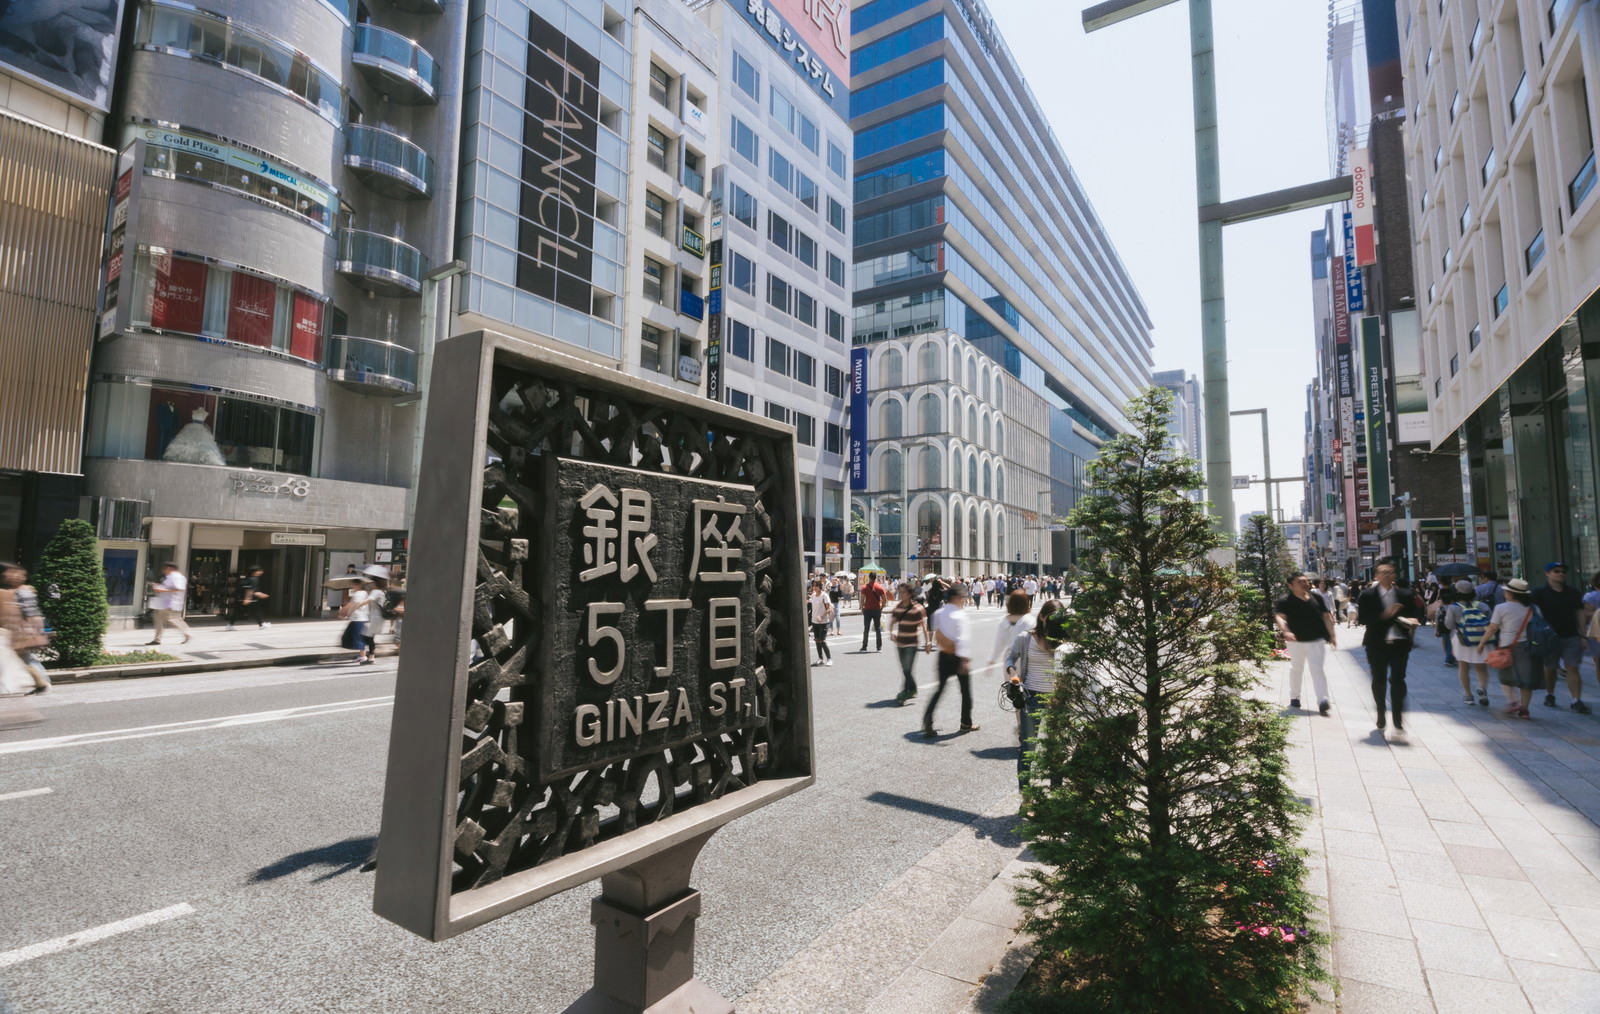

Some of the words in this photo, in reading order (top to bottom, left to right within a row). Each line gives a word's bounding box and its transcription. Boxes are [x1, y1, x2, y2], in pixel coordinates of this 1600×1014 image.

[163, 133, 190, 148] Gold
[193, 140, 220, 155] Plaza
[537, 47, 585, 268] FANCL
[269, 168, 298, 186] MEDICAL
[1354, 166, 1366, 210] docomo
[855, 358, 863, 395] MIZUHO
[1370, 366, 1381, 416] PRESTIA
[853, 440, 861, 480] みずほ銀行
[578, 483, 747, 584] 銀座
[586, 597, 742, 686] 5丁目
[575, 687, 693, 748] GINZA
[708, 677, 752, 717] ST.
